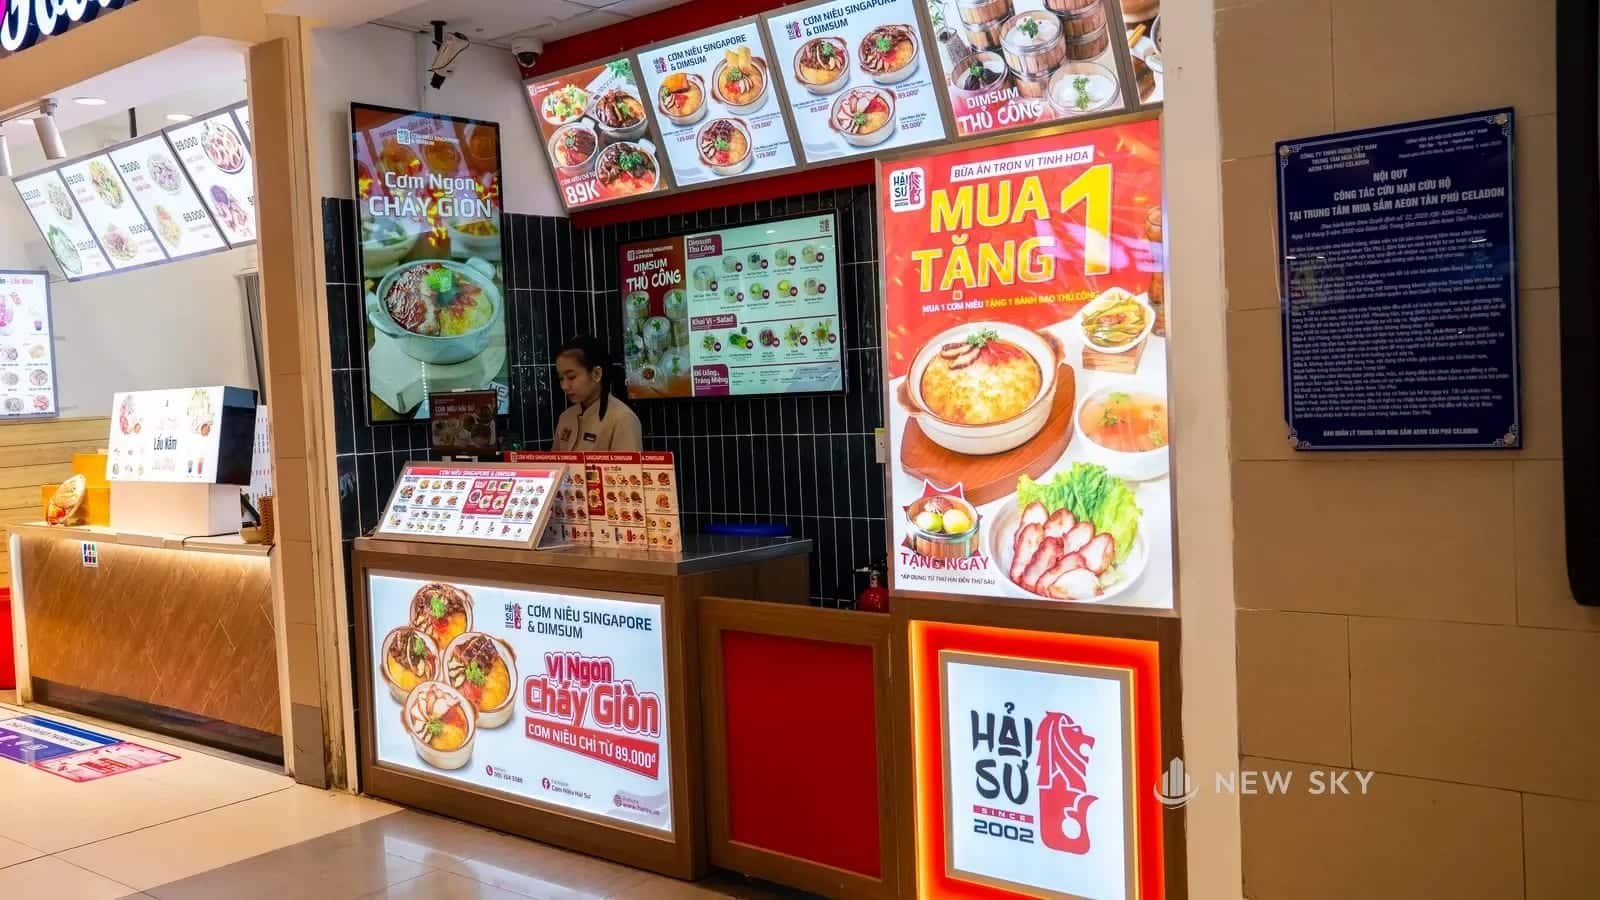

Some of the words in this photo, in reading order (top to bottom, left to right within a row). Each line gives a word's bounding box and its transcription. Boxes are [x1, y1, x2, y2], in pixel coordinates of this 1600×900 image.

[802, 15, 823, 26] CƠM
[823, 7, 844, 20] NIÊU
[806, 29, 813, 37] &
[812, 18, 849, 35] DIMSUM
[667, 52, 685, 62] CƠM
[685, 46, 703, 59] NIÊU
[703, 34, 748, 53] SINGAPORE
[671, 63, 681, 71] &
[681, 55, 707, 70] DIMSUM
[967, 87, 1019, 108] DIMSUM
[957, 105, 993, 132] THỦ
[998, 101, 1042, 126] CÔNG
[954, 165, 973, 178] BỮA
[976, 161, 992, 174] ĂN
[994, 159, 1022, 173] TRỌN
[1024, 158, 1036, 170] VỊ
[1038, 155, 1062, 166] TINH
[1065, 151, 1089, 163] HOA
[1373, 169, 1388, 184] NỘI
[1390, 168, 1407, 180] QUY
[385, 172, 424, 190] Cơm
[427, 173, 476, 193] Ngon
[893, 172, 908, 185] HẢI
[1333, 187, 1356, 201] CÔNG
[1358, 185, 1374, 198] TÁC
[1396, 182, 1415, 195] NẠN
[1418, 178, 1436, 191] CỨU
[1438, 176, 1451, 190] HỘ
[565, 179, 601, 204] 89K
[894, 185, 908, 198] SƯ
[931, 175, 1051, 233] MUA
[369, 192, 432, 217] CHÁY
[440, 193, 492, 218] GIÒN
[1288, 210, 1301, 223] TẠI
[1303, 207, 1330, 219] TRUNG
[1331, 203, 1350, 216] TÂM
[1351, 202, 1370, 213] MUA
[1372, 196, 1392, 211] SẮM
[1394, 197, 1418, 208] AEON
[1419, 192, 1438, 206] TÂN
[1440, 190, 1459, 203] PHÚ
[1461, 187, 1504, 201] CELADON
[1061, 163, 1112, 277] 1
[633, 258, 667, 273] DIMSUM
[911, 234, 1056, 300] TẶNG
[626, 271, 649, 292] THỦ
[651, 268, 681, 288] CÔNG
[923, 303, 939, 313] MUA
[901, 552, 944, 569] TẶNG
[945, 556, 989, 571] NGAY
[527, 604, 552, 619] CƠM
[555, 605, 580, 623] NIÊU
[583, 611, 652, 632] SINGAPORE
[528, 621, 536, 632] &
[538, 622, 583, 639] DIMSUM
[545, 654, 564, 684] Vị
[566, 654, 612, 688] Ngon
[525, 677, 589, 728] Cháy
[593, 682, 658, 734] Giòn
[528, 724, 551, 739] CƠM
[553, 729, 577, 747] NIÊU
[580, 734, 597, 753] CHỈ
[599, 740, 613, 757] TỪ
[970, 701, 1033, 759] HẢI
[975, 758, 1029, 805] SƯ
[981, 808, 1028, 822] SINCE
[974, 818, 1035, 844] 2002
